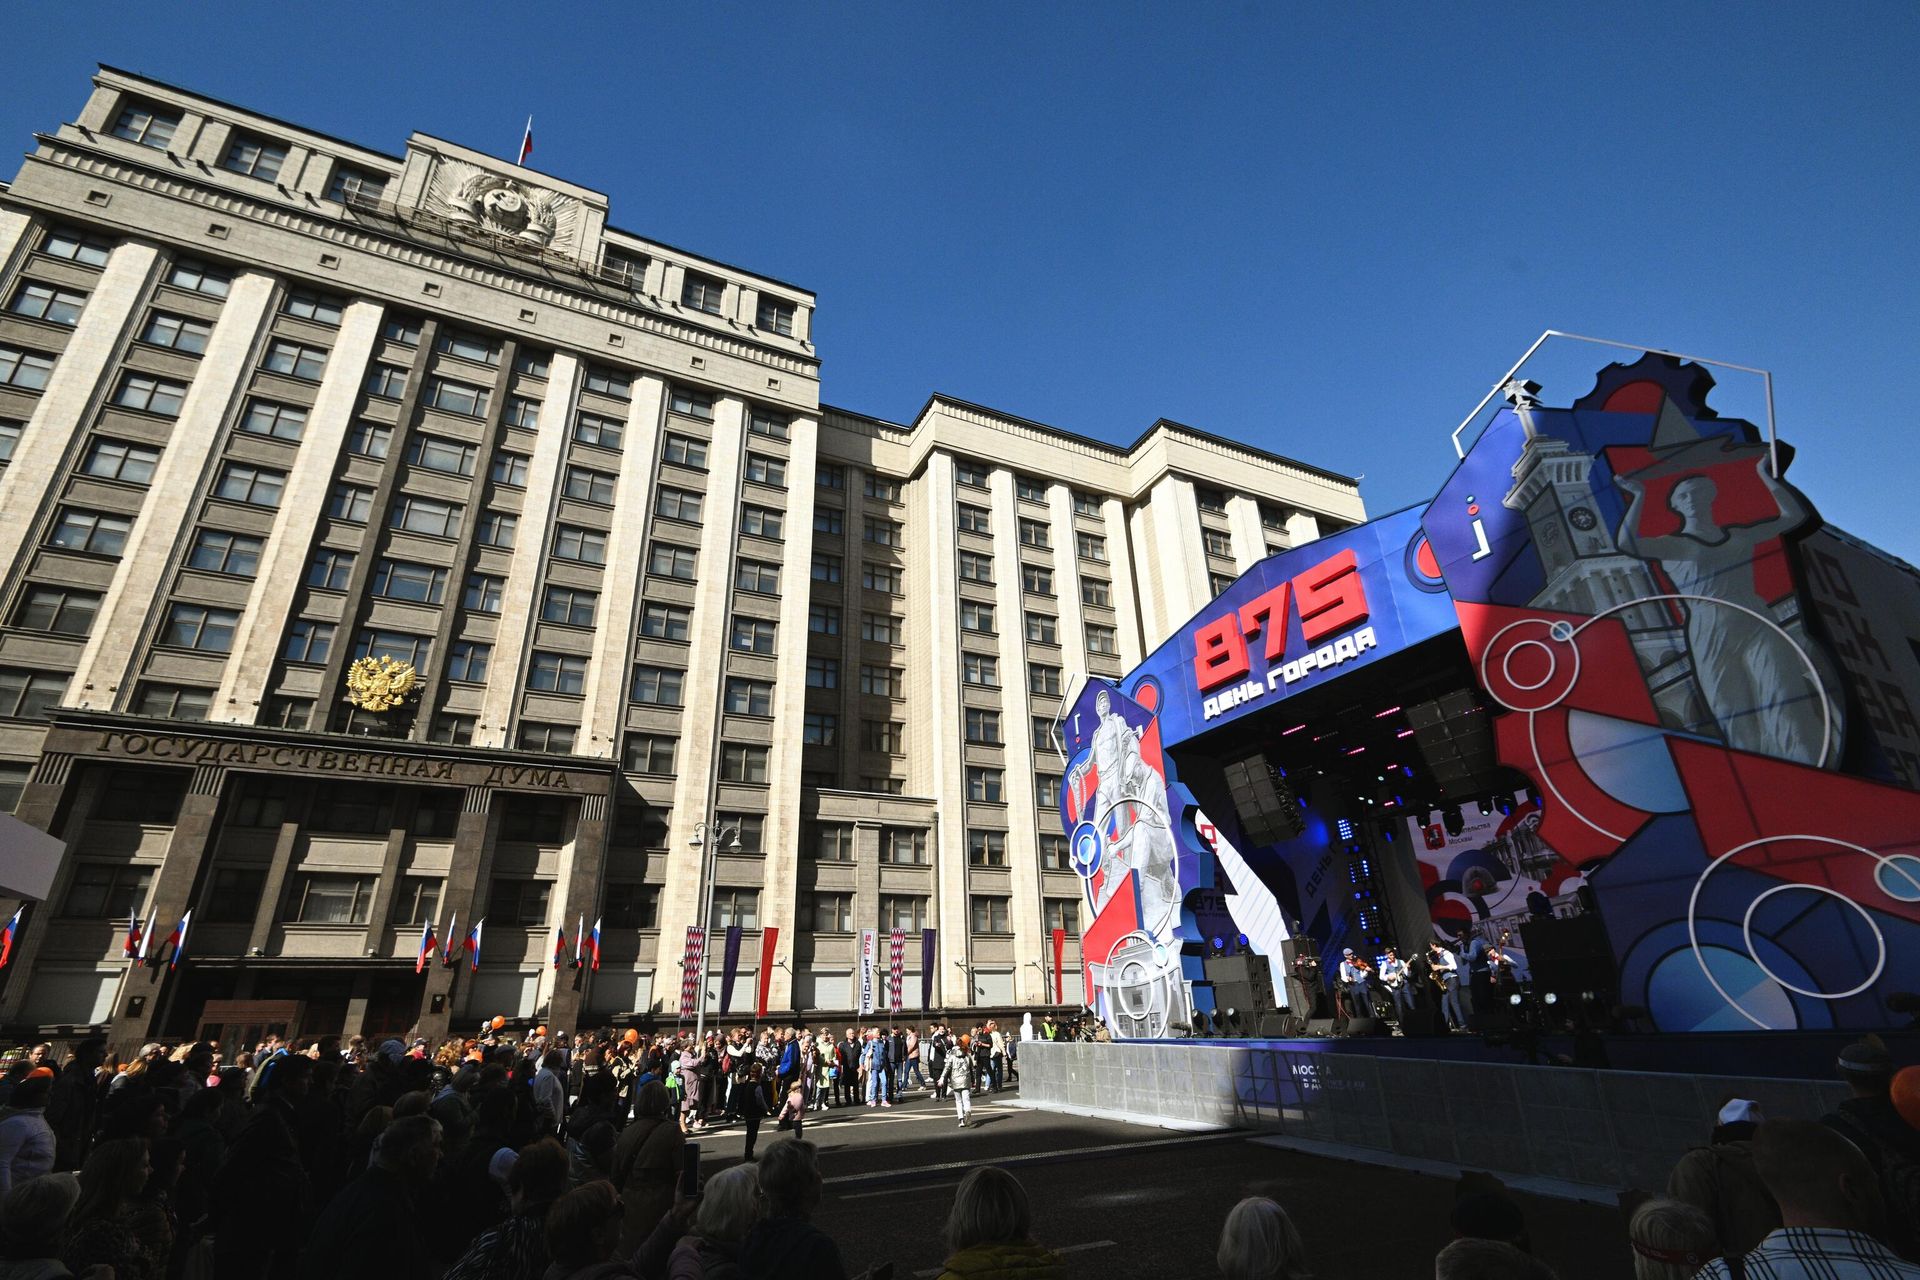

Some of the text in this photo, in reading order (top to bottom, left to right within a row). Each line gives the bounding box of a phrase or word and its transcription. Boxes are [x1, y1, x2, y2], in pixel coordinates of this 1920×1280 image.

[1193, 547, 1370, 694] 875
[1203, 626, 1377, 720] ДЕНЬ ГОРОДА
[96, 731, 571, 789] ГОСУДАРСТВЕННАЯ ДУМА
[863, 934, 872, 1009] МОСКВА 875
